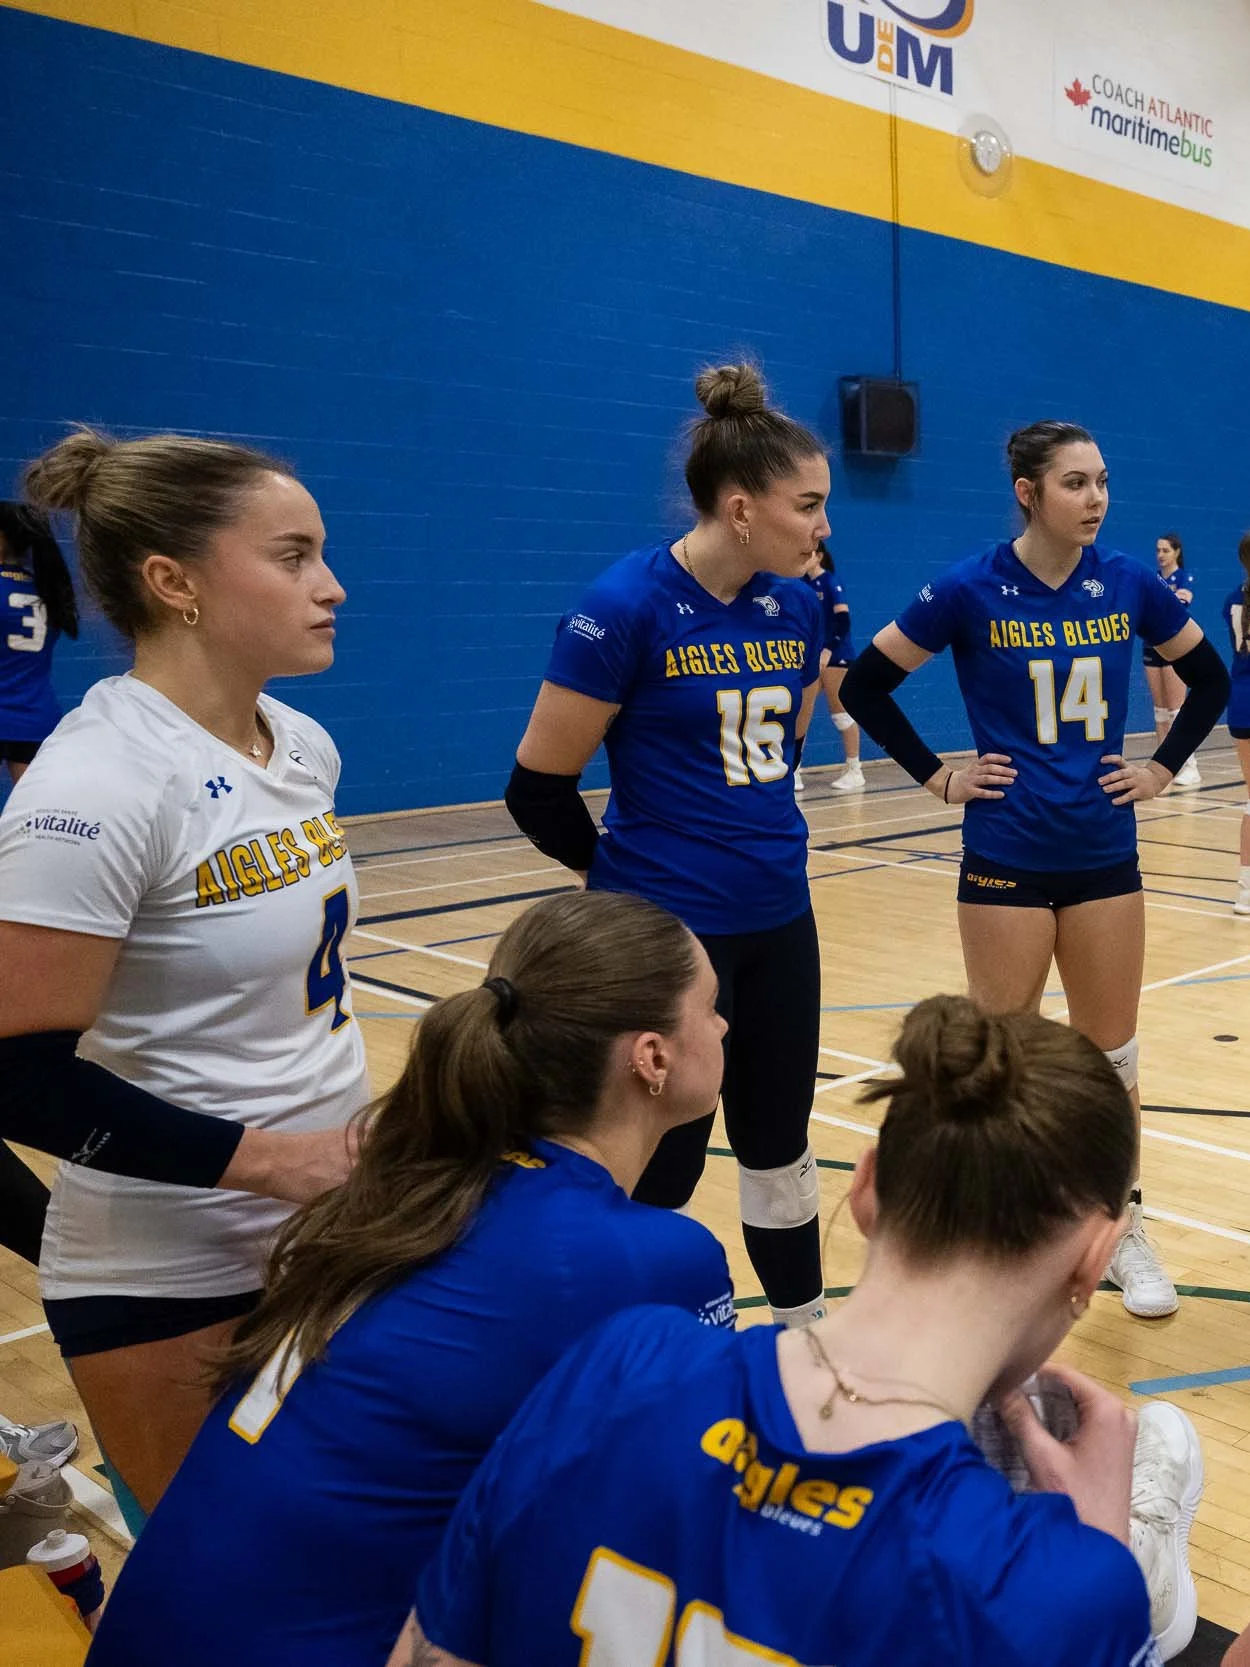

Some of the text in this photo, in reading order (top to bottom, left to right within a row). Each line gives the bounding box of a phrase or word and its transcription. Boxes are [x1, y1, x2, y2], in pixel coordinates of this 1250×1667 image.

[1090, 105, 1214, 168] maritimebus
[1092, 74, 1214, 138] COACH ATLANTIC
[7, 592, 48, 652] 3
[989, 612, 1130, 649] AIGLES BLEUES
[665, 643, 741, 679] AIGLES
[716, 685, 792, 787] 16
[1028, 656, 1109, 745] 14
[34, 814, 101, 840] vitalité
[195, 809, 348, 908] AIGLES BLE
[305, 882, 353, 1034] 4
[701, 1418, 873, 1530] aigles
[570, 1546, 810, 1667] 1
